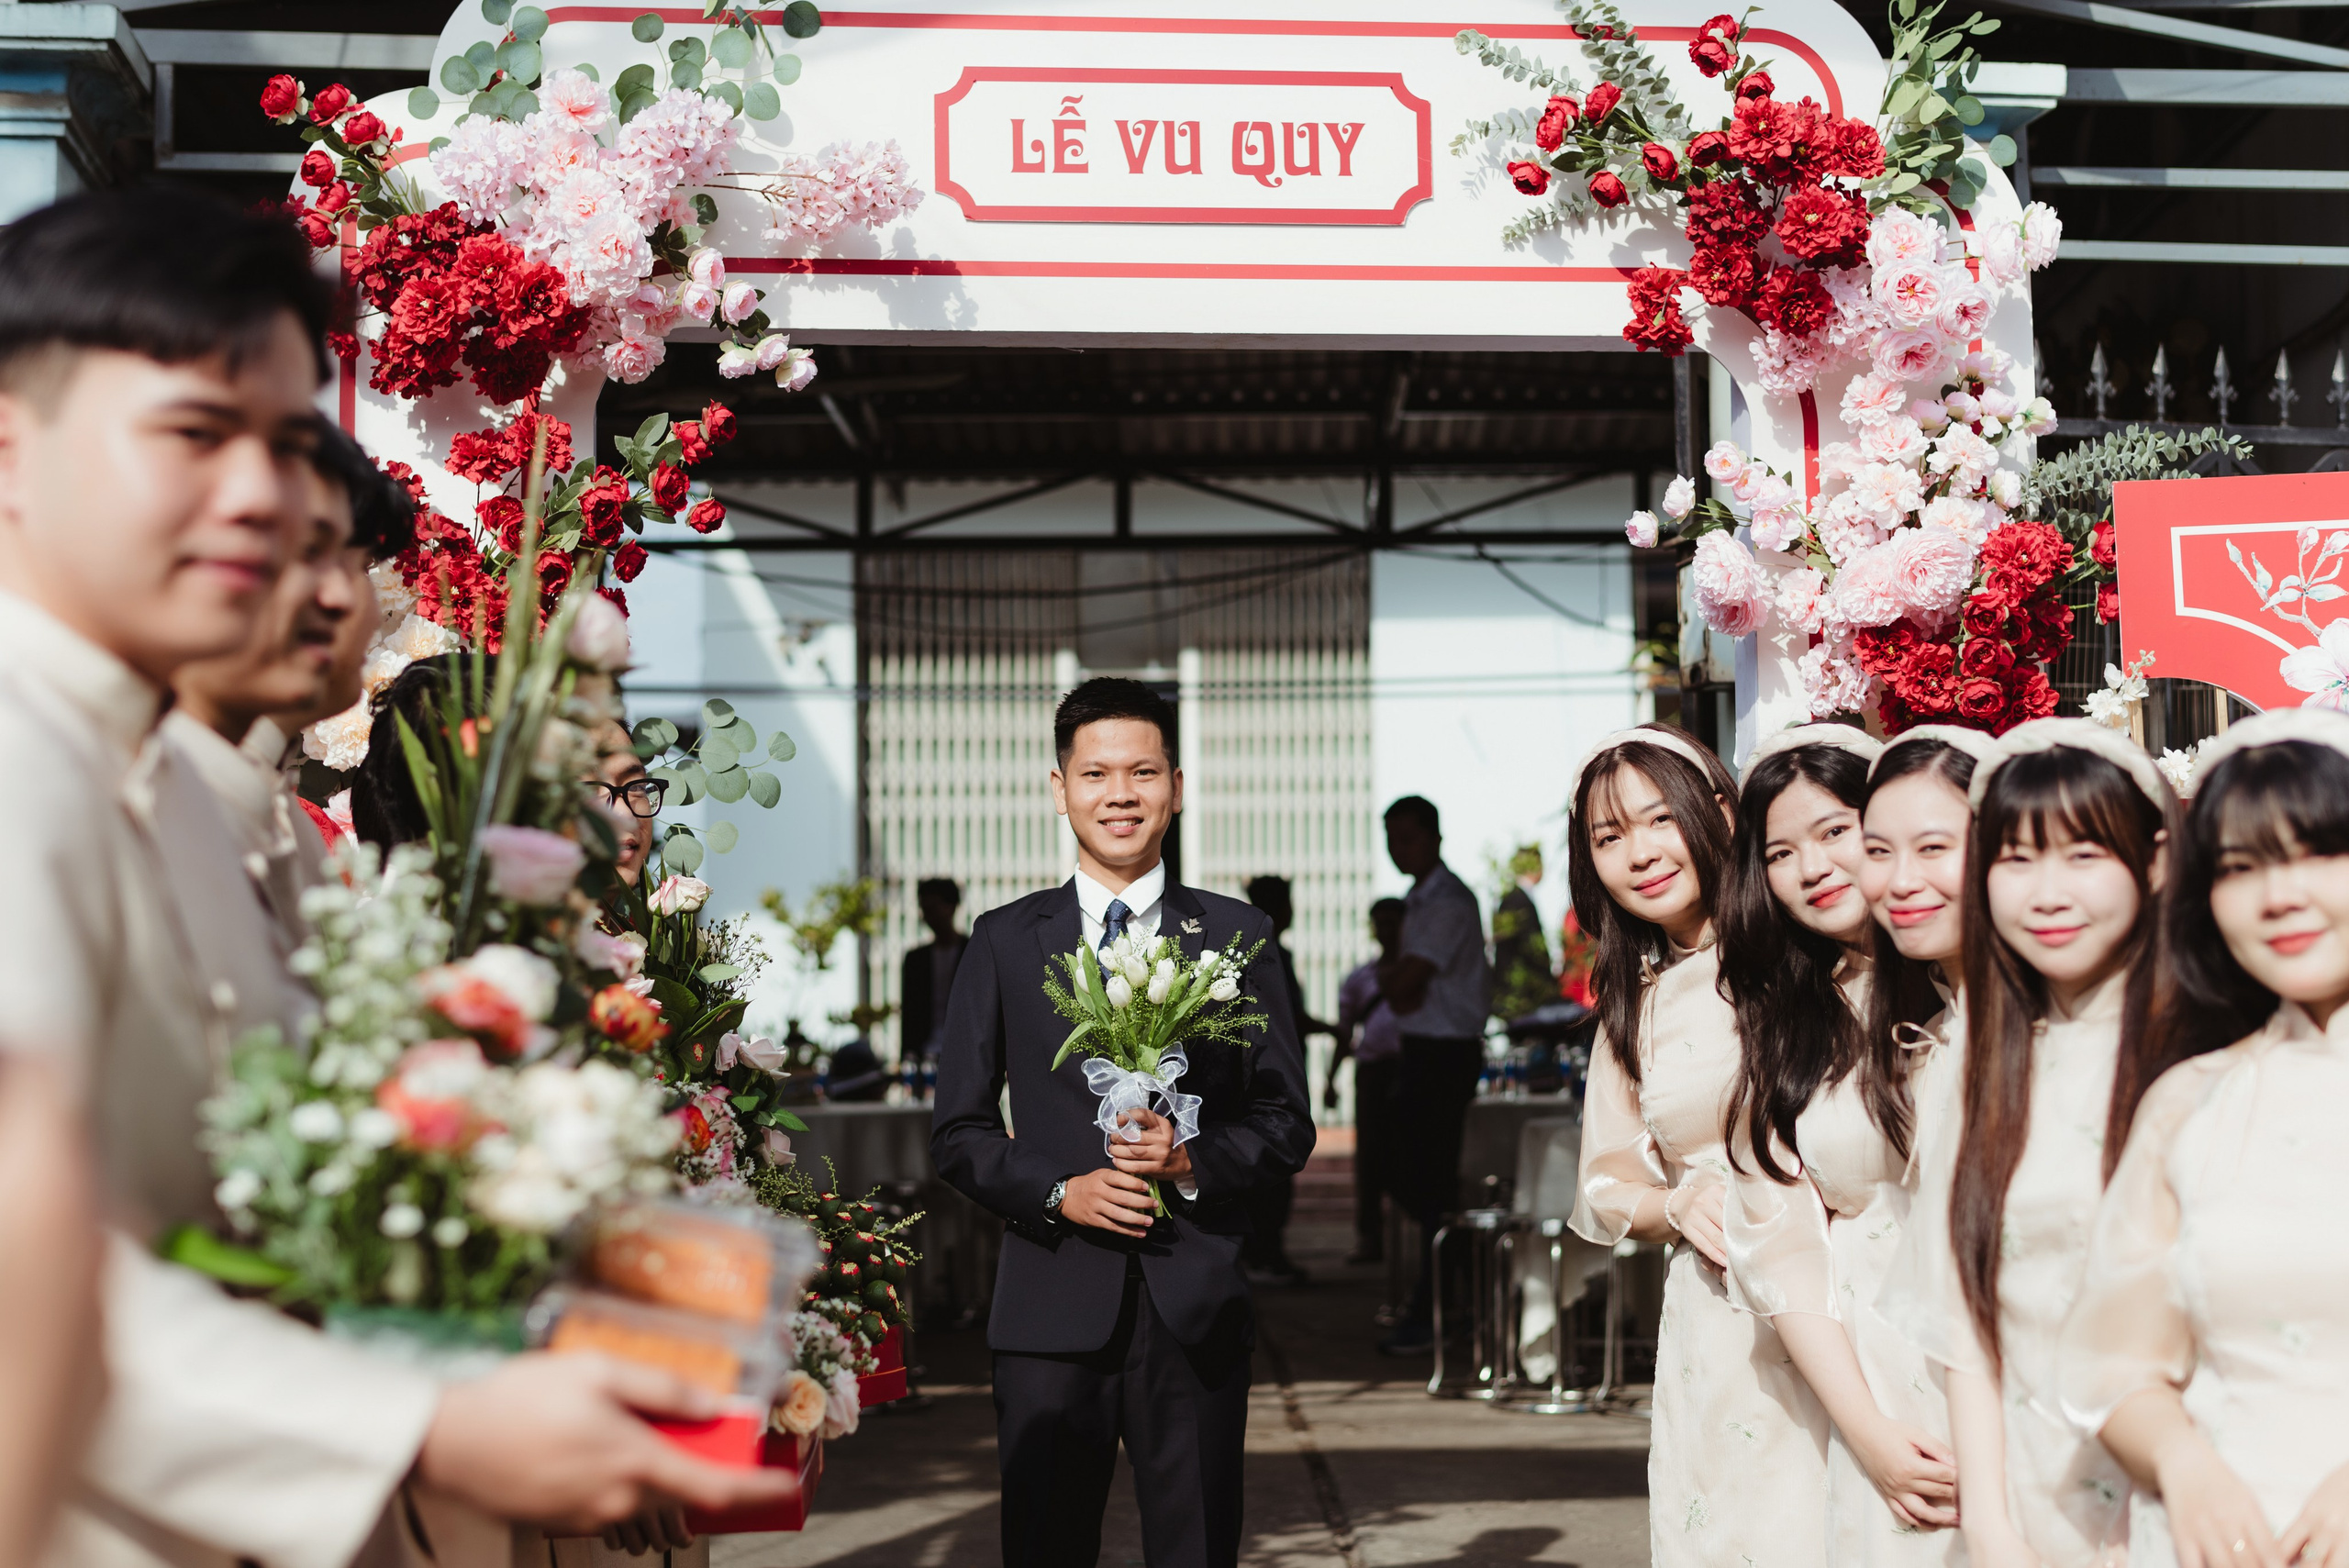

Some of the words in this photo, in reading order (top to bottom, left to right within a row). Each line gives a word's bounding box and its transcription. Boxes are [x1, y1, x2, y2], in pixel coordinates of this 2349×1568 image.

[1010, 95, 1089, 173] LỄ
[1114, 119, 1203, 175] VU
[1231, 121, 1365, 188] QUY
